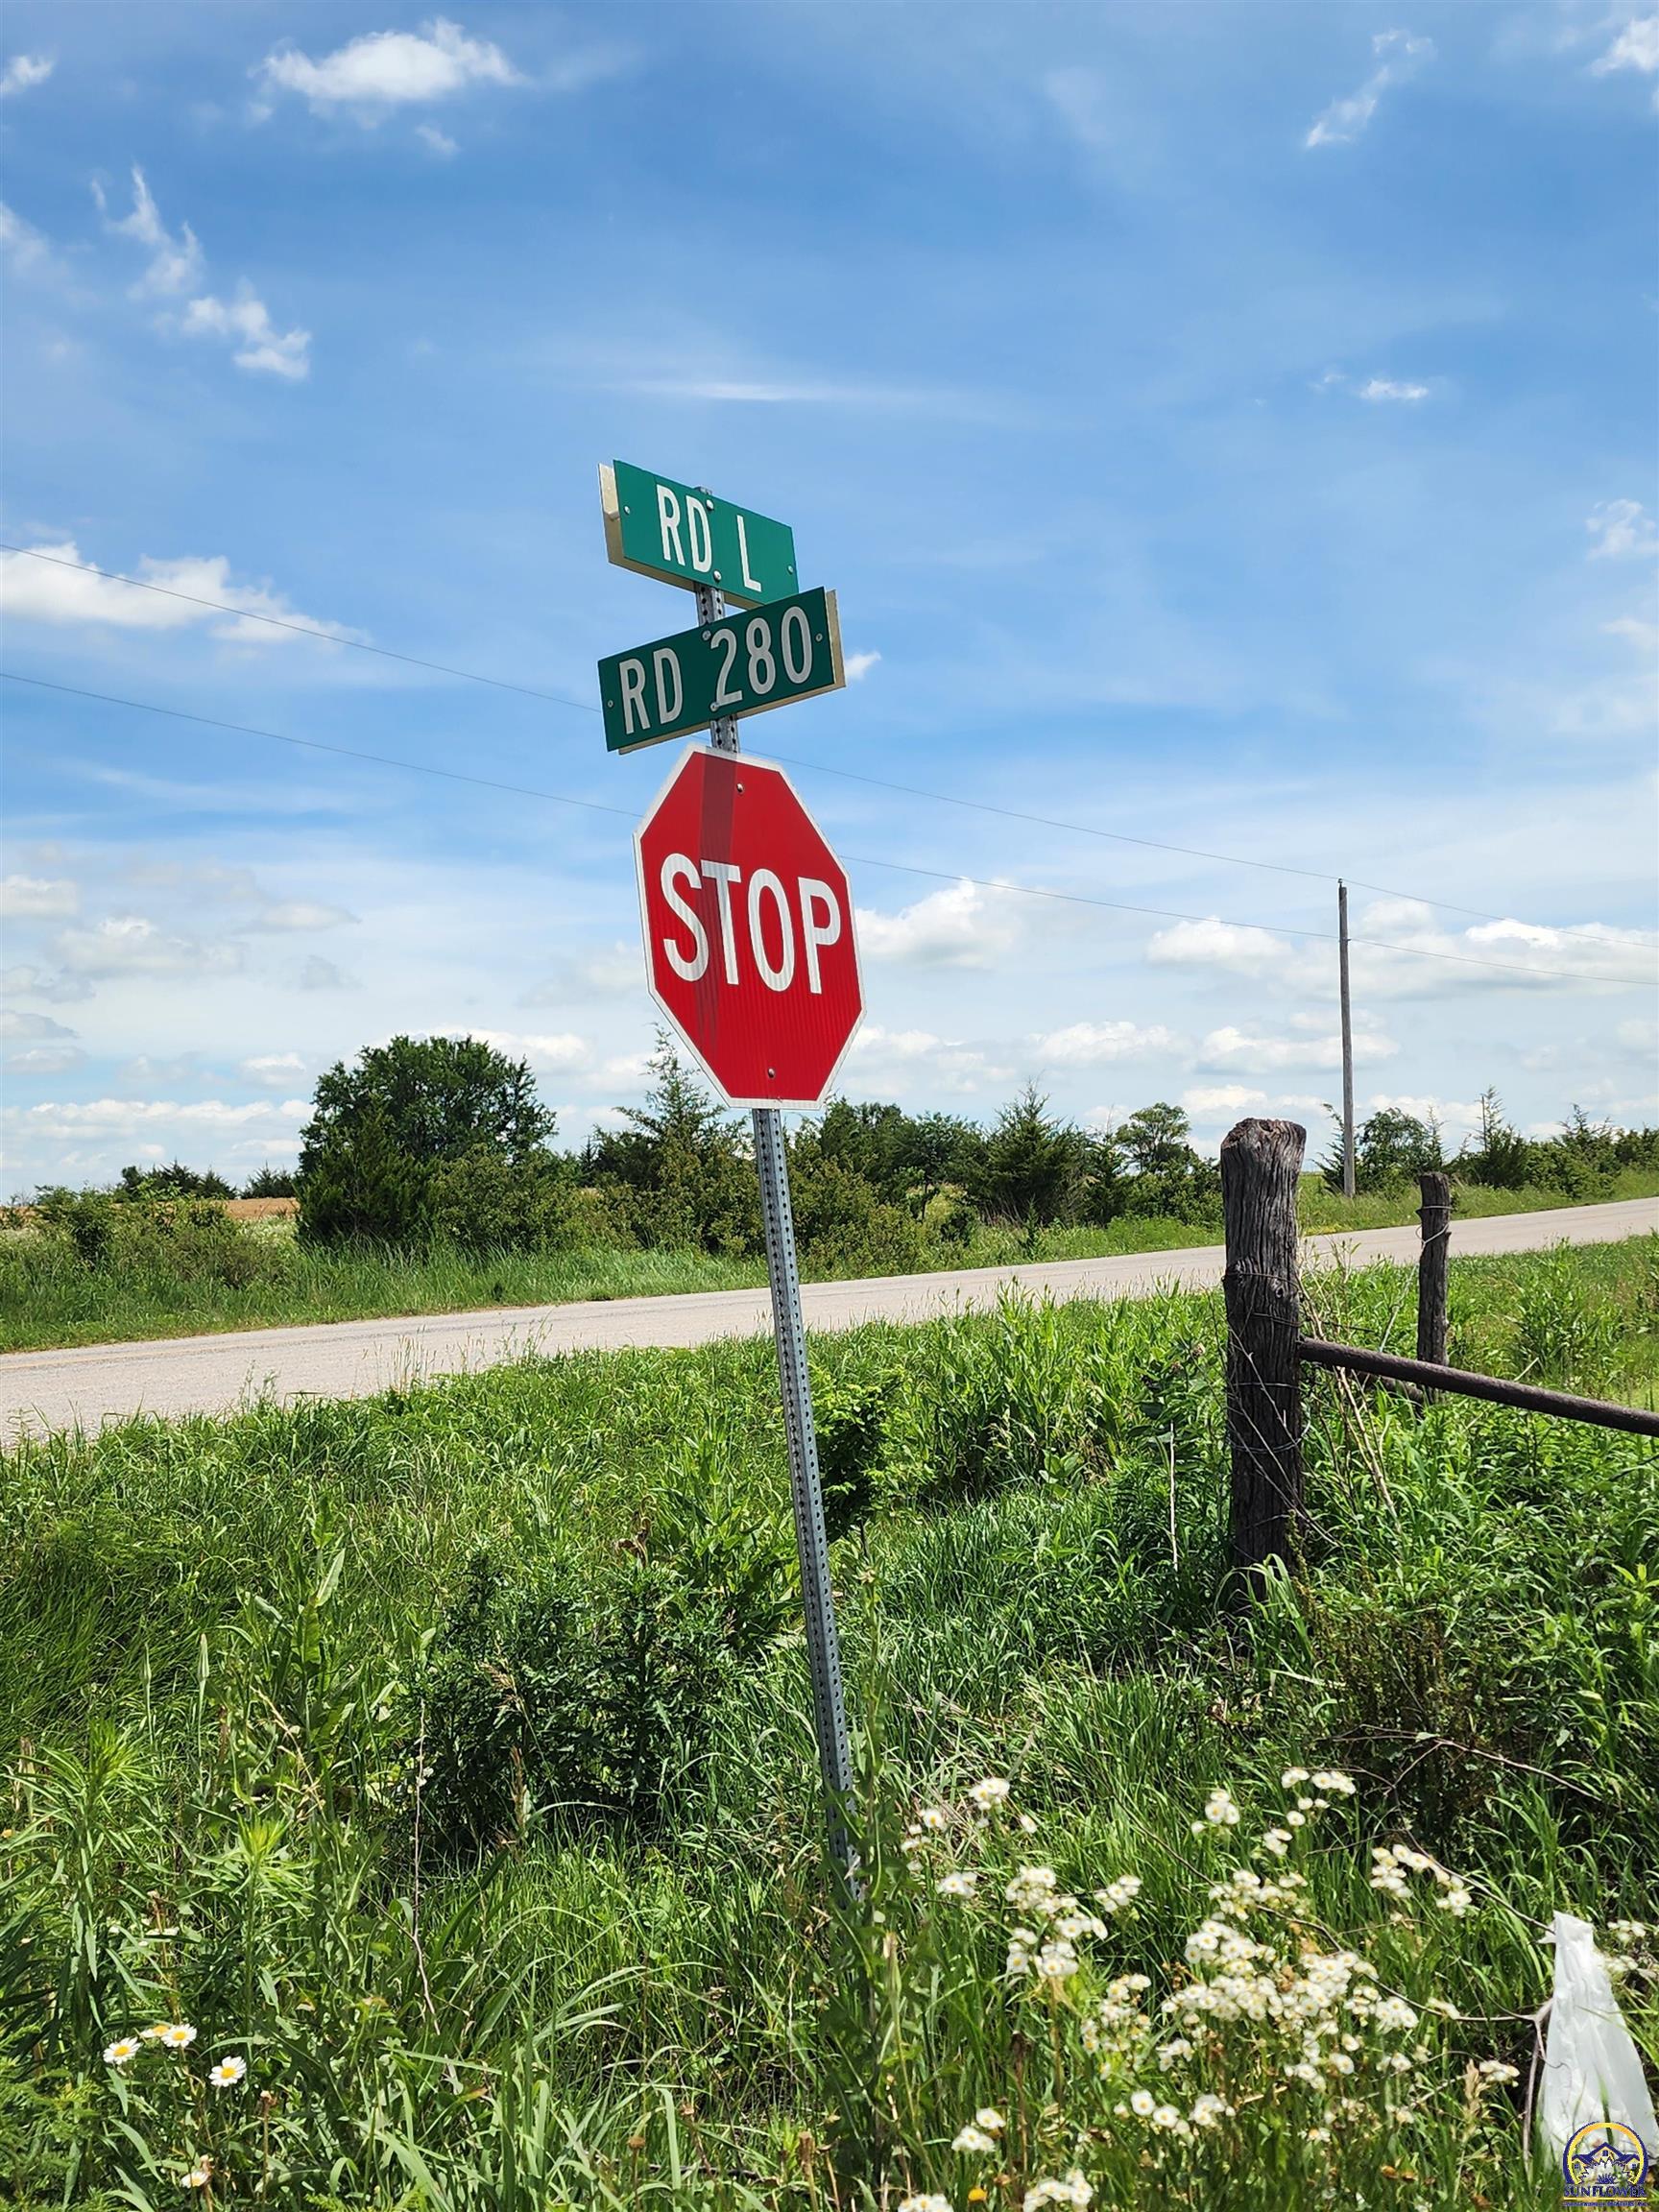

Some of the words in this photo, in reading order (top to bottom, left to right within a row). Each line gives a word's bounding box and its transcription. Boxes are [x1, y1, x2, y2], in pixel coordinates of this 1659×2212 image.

[736, 515, 761, 592] L
[618, 647, 683, 734] RD
[709, 606, 813, 707] 280
[661, 853, 841, 995] STOP
